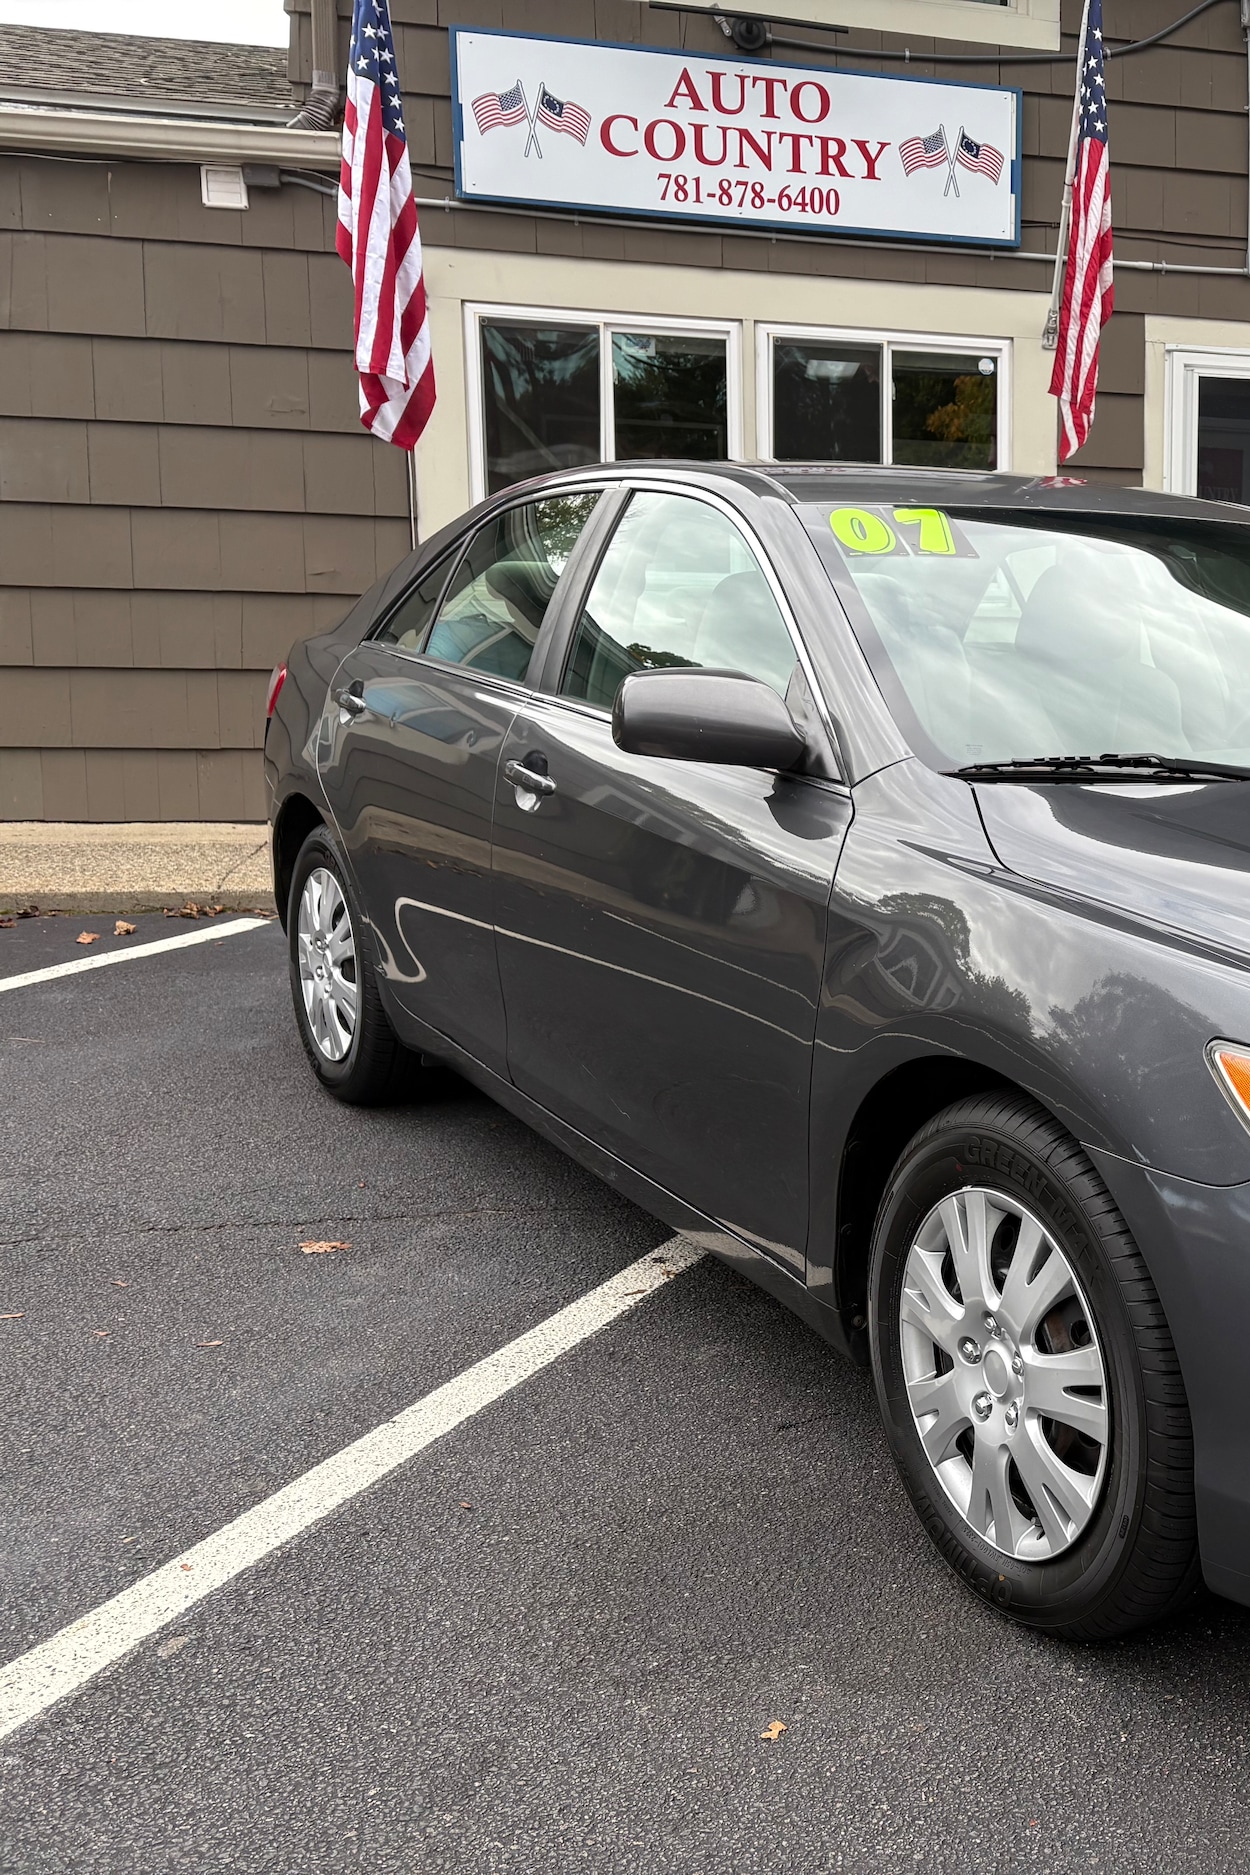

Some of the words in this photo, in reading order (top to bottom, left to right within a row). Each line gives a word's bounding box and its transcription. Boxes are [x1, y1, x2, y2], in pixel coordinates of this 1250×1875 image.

[664, 67, 831, 123] AUTO
[599, 113, 892, 182] COUNTRY
[656, 172, 841, 216] 781-878-6400
[829, 507, 957, 555] 07
[963, 1136, 1048, 1199] GREEN
